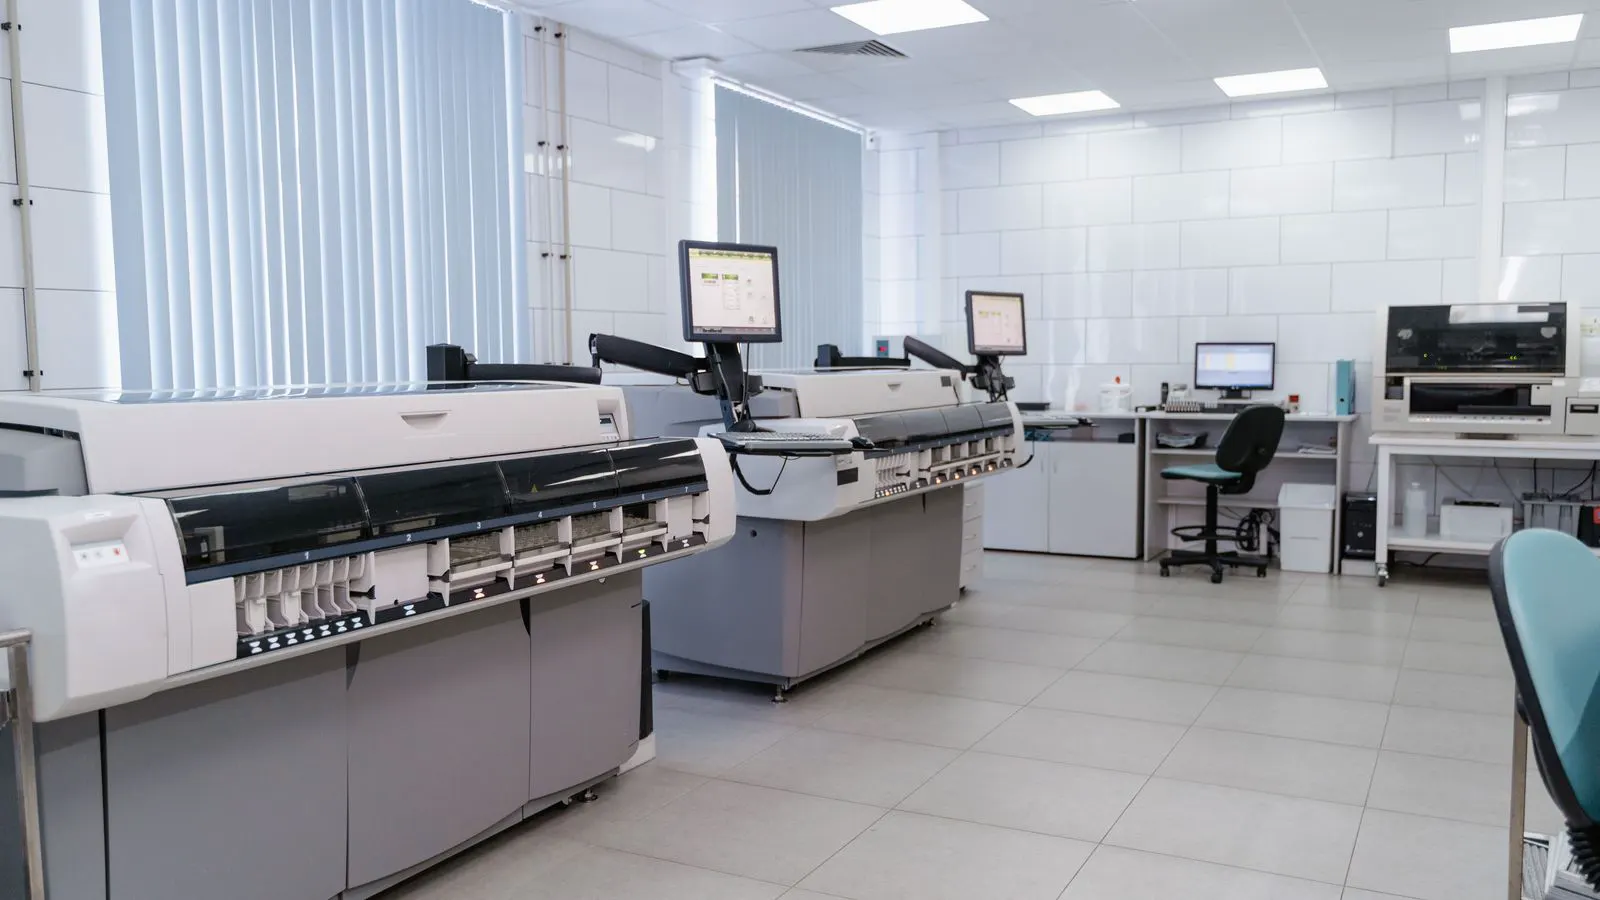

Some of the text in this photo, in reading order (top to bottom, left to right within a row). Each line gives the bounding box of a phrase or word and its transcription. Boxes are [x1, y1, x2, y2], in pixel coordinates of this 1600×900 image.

[304, 551, 309, 560] 1
[406, 533, 412, 542] 2
[476, 521, 482, 529] 3
[592, 501, 597, 509] 5
